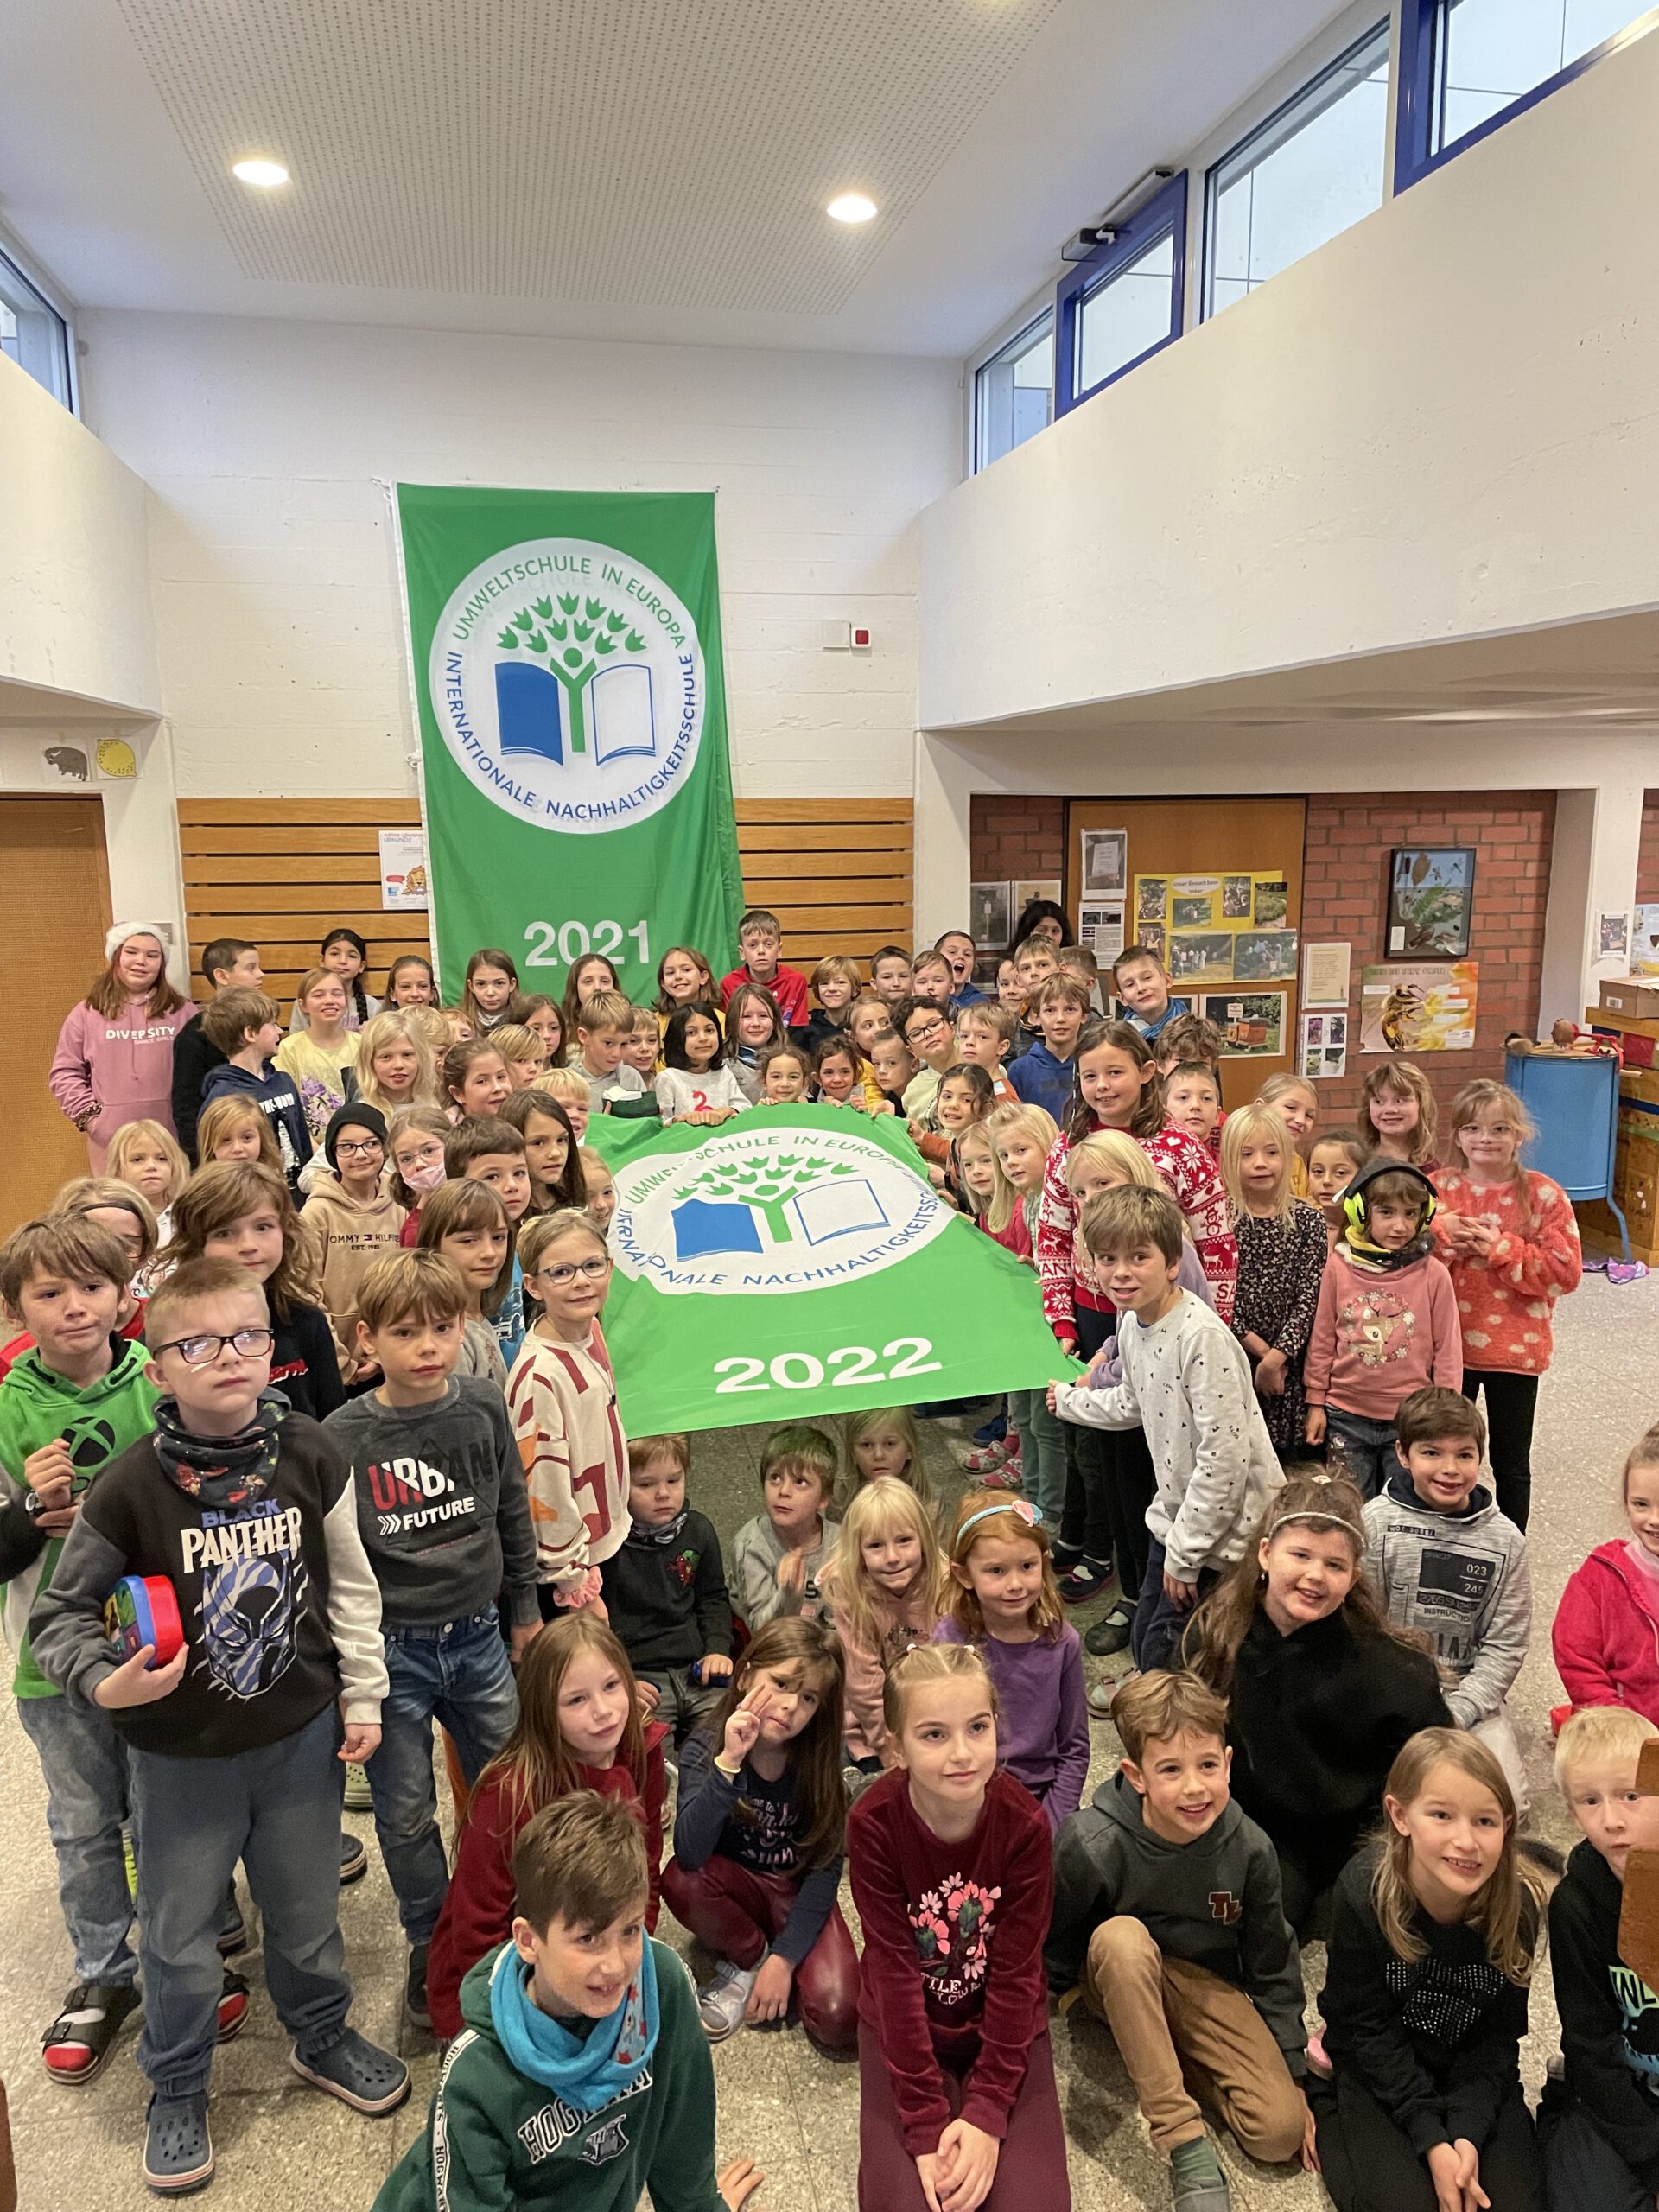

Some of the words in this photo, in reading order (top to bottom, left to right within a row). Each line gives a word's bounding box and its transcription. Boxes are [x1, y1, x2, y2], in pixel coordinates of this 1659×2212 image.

[453, 556, 591, 641] UMWELTSCHULE
[601, 563, 623, 586] IN
[625, 577, 687, 649] EUROPA
[445, 651, 537, 808] INTERNATIONALE
[545, 652, 696, 819] NACHHALTIGKEITSSCHULE
[524, 919, 650, 967] 2021
[105, 1026, 175, 1040] DIVERSITY
[793, 1135, 819, 1146] IN
[329, 1235, 360, 1243] OMMY
[713, 1337, 943, 1394] 2022
[201, 1498, 283, 1529] BLACK
[402, 1497, 476, 1531] FUTURE
[180, 1506, 302, 1574] PANTHER
[1466, 1563, 1488, 1577] 023
[1424, 1607, 1471, 1623] INSTRUCTIO
[920, 1972, 962, 1994] TTLE
